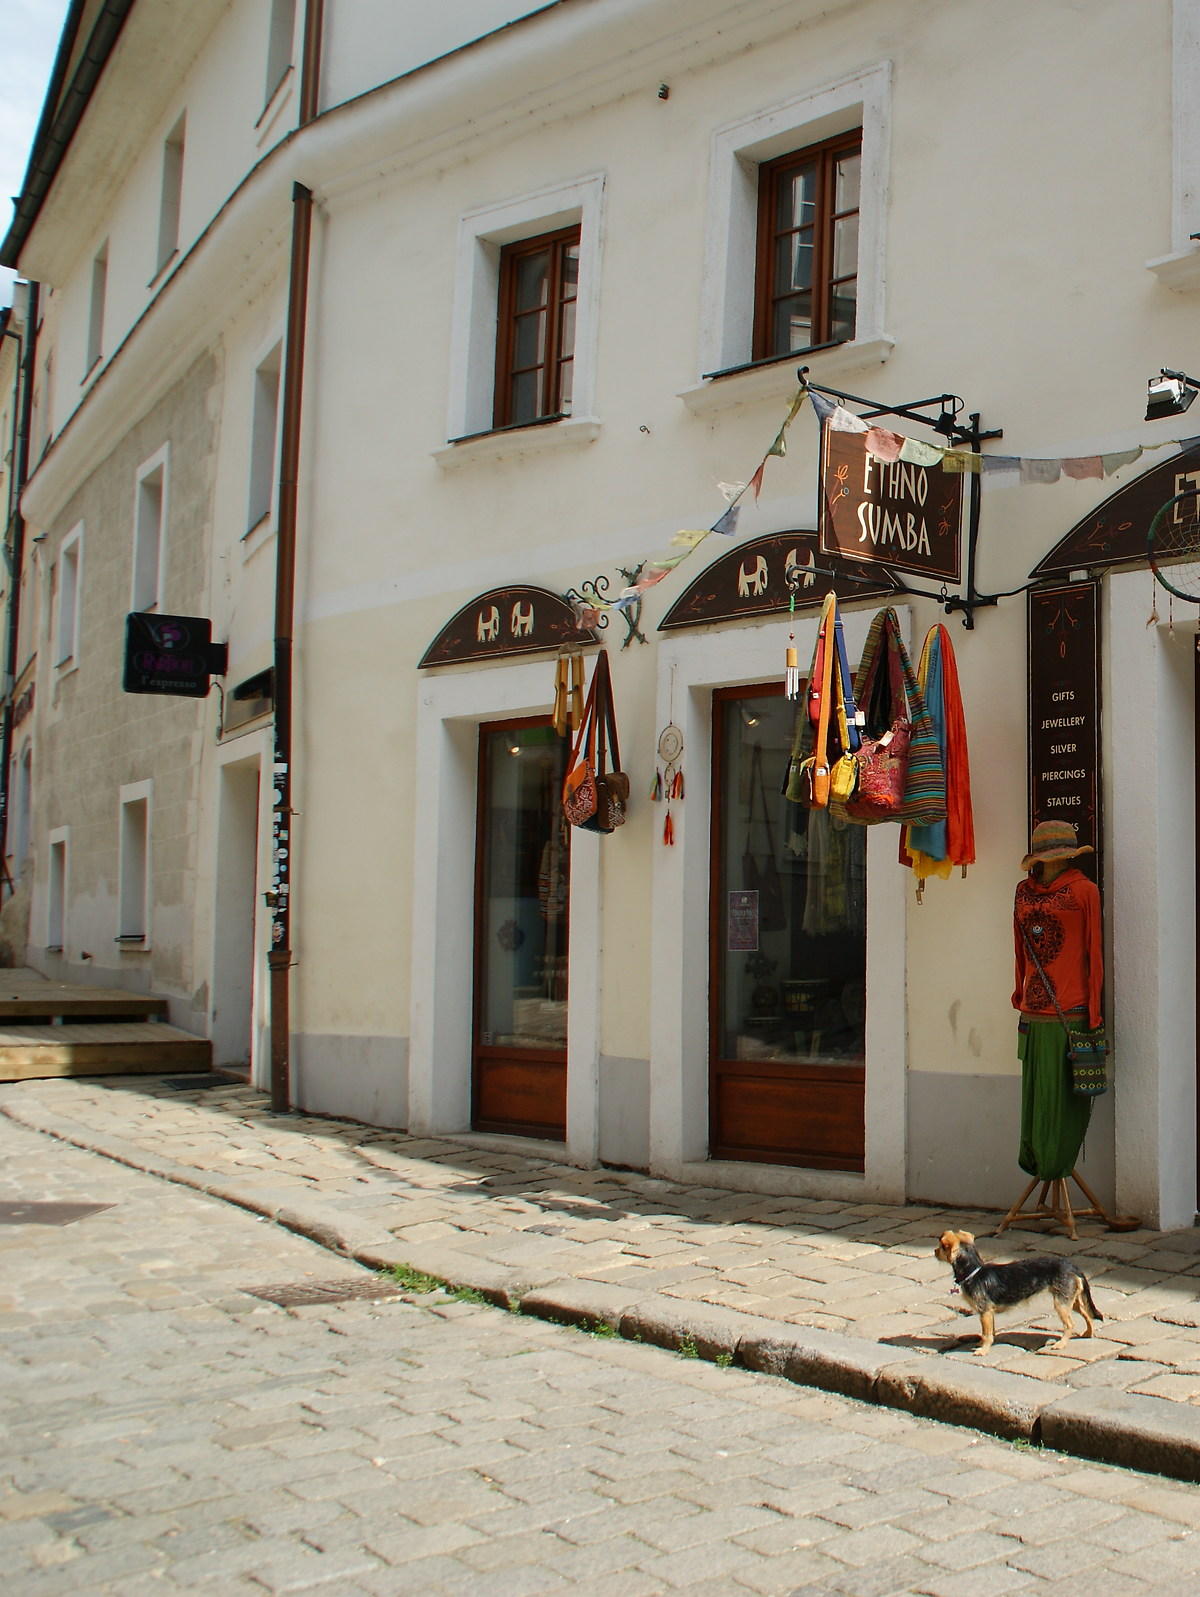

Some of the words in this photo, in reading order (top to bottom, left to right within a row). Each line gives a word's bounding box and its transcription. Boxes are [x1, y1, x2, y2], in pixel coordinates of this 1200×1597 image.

[863, 452, 928, 507] ETHNO
[857, 501, 931, 556] SUMBA
[142, 675, 197, 689] l'espresso
[1052, 691, 1075, 702] GIFTS
[1041, 716, 1085, 729] JEWELLERY
[1050, 743, 1077, 754] SILVER
[1042, 769, 1086, 781] PIERCINGS
[1047, 796, 1081, 807] STATUES
